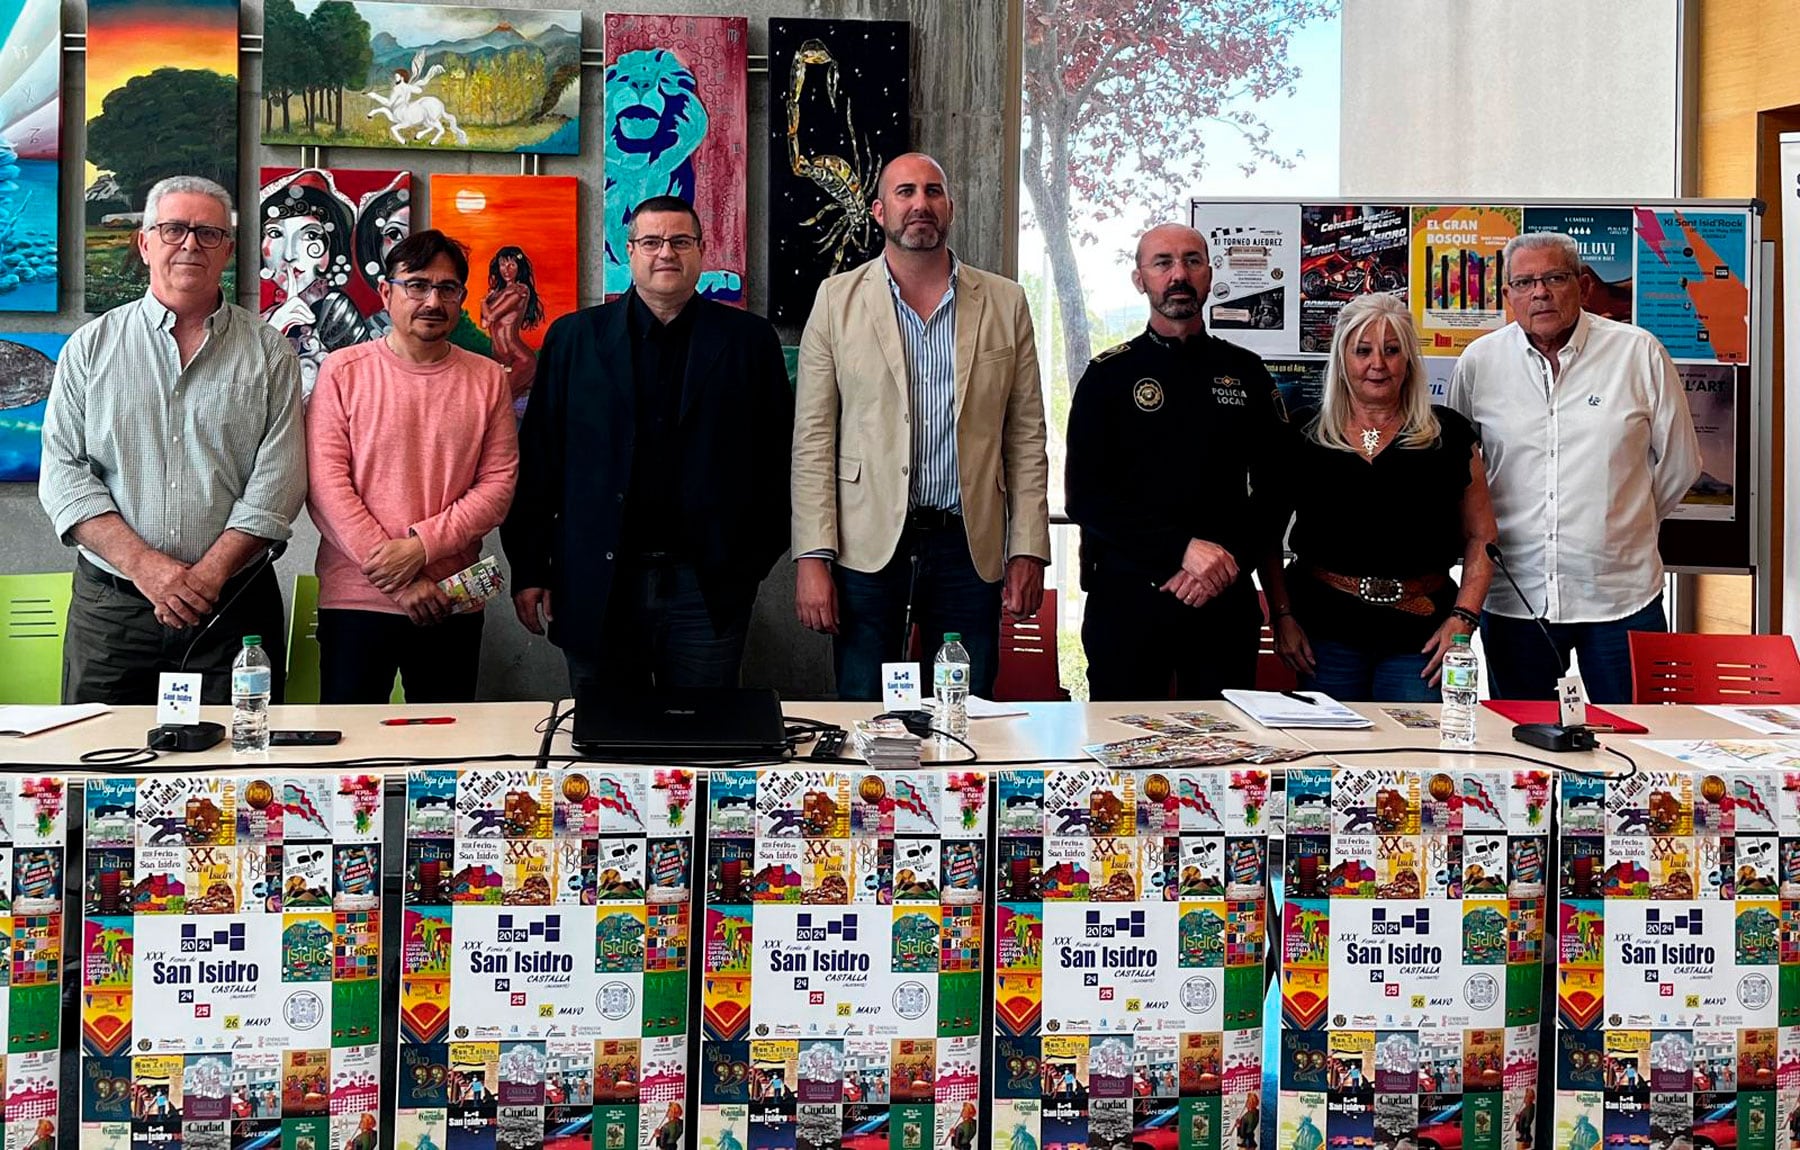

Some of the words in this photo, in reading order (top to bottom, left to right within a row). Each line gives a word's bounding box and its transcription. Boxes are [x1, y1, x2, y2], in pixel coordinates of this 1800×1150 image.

[1426, 220, 1440, 230] EL
[1442, 220, 1478, 230] GRAN
[1675, 219, 1697, 227] Sant
[1426, 234, 1478, 246] BOSQUE
[1216, 396, 1245, 406] LOCAL
[456, 794, 478, 814] San
[472, 771, 505, 799] Isidro
[756, 794, 778, 814] San
[772, 771, 803, 799] Isidro
[1044, 793, 1065, 813] San
[1059, 770, 1090, 798] Isidro
[1120, 778, 1135, 813] Isidro
[1331, 792, 1352, 811] San
[1346, 769, 1376, 796] Isidro
[1405, 777, 1420, 812] Isidro
[1605, 794, 1625, 813] San
[1619, 772, 1648, 798] Isidro
[136, 802, 159, 823] San
[152, 778, 186, 806] Isidro
[536, 778, 552, 815] Isidro
[834, 779, 849, 815] Isidro
[1677, 779, 1692, 814] Isidro
[218, 785, 235, 822] Isidro
[536, 816, 552, 837] San
[834, 817, 849, 838] San
[1120, 815, 1135, 836] San
[1405, 814, 1420, 834] San
[1678, 815, 1692, 835] San
[218, 824, 235, 845] San
[505, 840, 533, 857] XX
[804, 840, 830, 857] XX
[1092, 838, 1117, 855] XX
[1378, 836, 1402, 853] XX
[1651, 837, 1675, 854] XX
[187, 848, 215, 866] XX
[1086, 927, 1098, 936] 20
[1101, 926, 1113, 935] 24
[1372, 924, 1384, 932] 20
[1387, 923, 1398, 932] 24
[1646, 924, 1658, 932] 20
[1661, 924, 1672, 932] 24
[498, 931, 511, 940] 20
[514, 930, 526, 940] 24
[797, 930, 810, 939] 20
[812, 930, 824, 939] 24
[1338, 933, 1358, 941] XXX
[1613, 933, 1632, 941] XXX
[181, 940, 194, 950] 20
[197, 940, 210, 949] 24
[461, 941, 482, 949] XXX
[762, 939, 782, 948] XXX
[1052, 936, 1072, 945] XXX
[143, 951, 165, 960] XXX
[1060, 946, 1095, 968] San
[1102, 946, 1157, 967] Isidro
[1347, 942, 1381, 964] San
[1388, 943, 1441, 964] Isidro
[1622, 942, 1655, 964] San
[1662, 943, 1715, 964] Isidro
[470, 950, 507, 973] San
[514, 950, 573, 972] Isidro
[770, 949, 806, 971] San
[813, 950, 869, 971] Isidro
[153, 961, 190, 984] San
[198, 960, 258, 982] Isidro
[1372, 971, 1382, 980] 24
[1399, 966, 1440, 974] CASTALLA
[1646, 971, 1656, 980] 24
[527, 974, 570, 982] CASTALLA
[825, 973, 867, 981] CASTALLA
[1086, 975, 1096, 984] 24
[211, 984, 256, 993] CASTALLA
[497, 980, 508, 990] 24
[796, 979, 806, 988] 24
[1100, 989, 1112, 998] 25
[1386, 985, 1397, 994] 25
[1660, 985, 1671, 994] 25
[180, 991, 192, 1001] 24
[512, 994, 524, 1004] 25
[810, 993, 822, 1002] 25
[196, 1005, 208, 1015] 25
[541, 1007, 552, 1015] 26
[558, 1006, 584, 1015] MAYO
[838, 1006, 849, 1014] 26
[855, 1006, 880, 1014] MAYO
[1128, 1001, 1138, 1009] 26
[1144, 1001, 1168, 1009] MAYO
[226, 1018, 238, 1027] 26
[244, 1017, 271, 1026] MAYO
[1094, 1099, 1126, 1110] Ciudad
[1380, 1095, 1411, 1106] Ciudad
[503, 1108, 537, 1119] Ciudad
[802, 1105, 836, 1116] Ciudad
[189, 1122, 224, 1133] Ciudad
